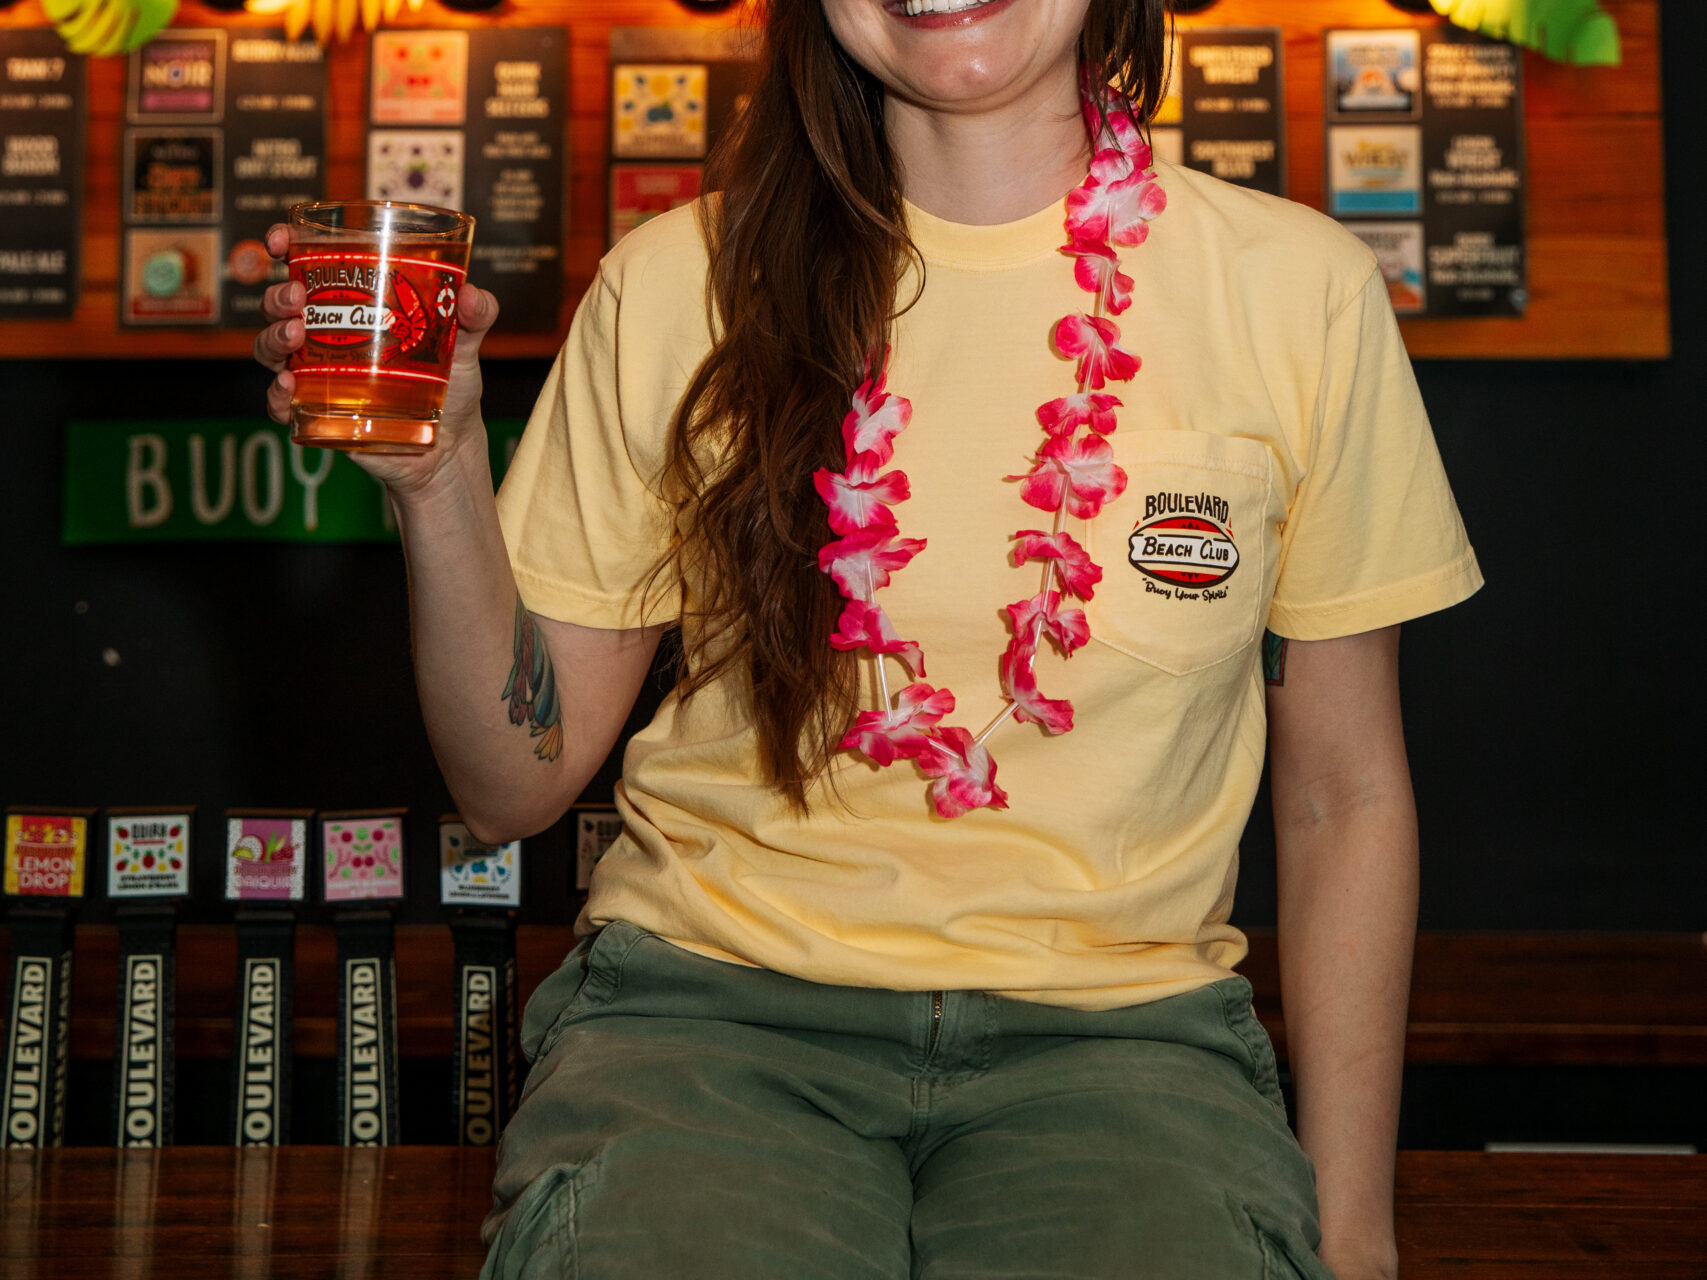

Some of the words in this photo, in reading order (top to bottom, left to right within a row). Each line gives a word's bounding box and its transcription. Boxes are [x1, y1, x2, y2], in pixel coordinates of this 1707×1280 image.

[126, 431, 334, 531] BUOY
[1142, 491, 1229, 524] BOULEVARD
[1142, 536, 1193, 557] BEACH
[1200, 539, 1229, 561] CLUB
[1175, 587, 1199, 600] Your
[13, 856, 77, 873] LEMON
[20, 872, 69, 889] DROP
